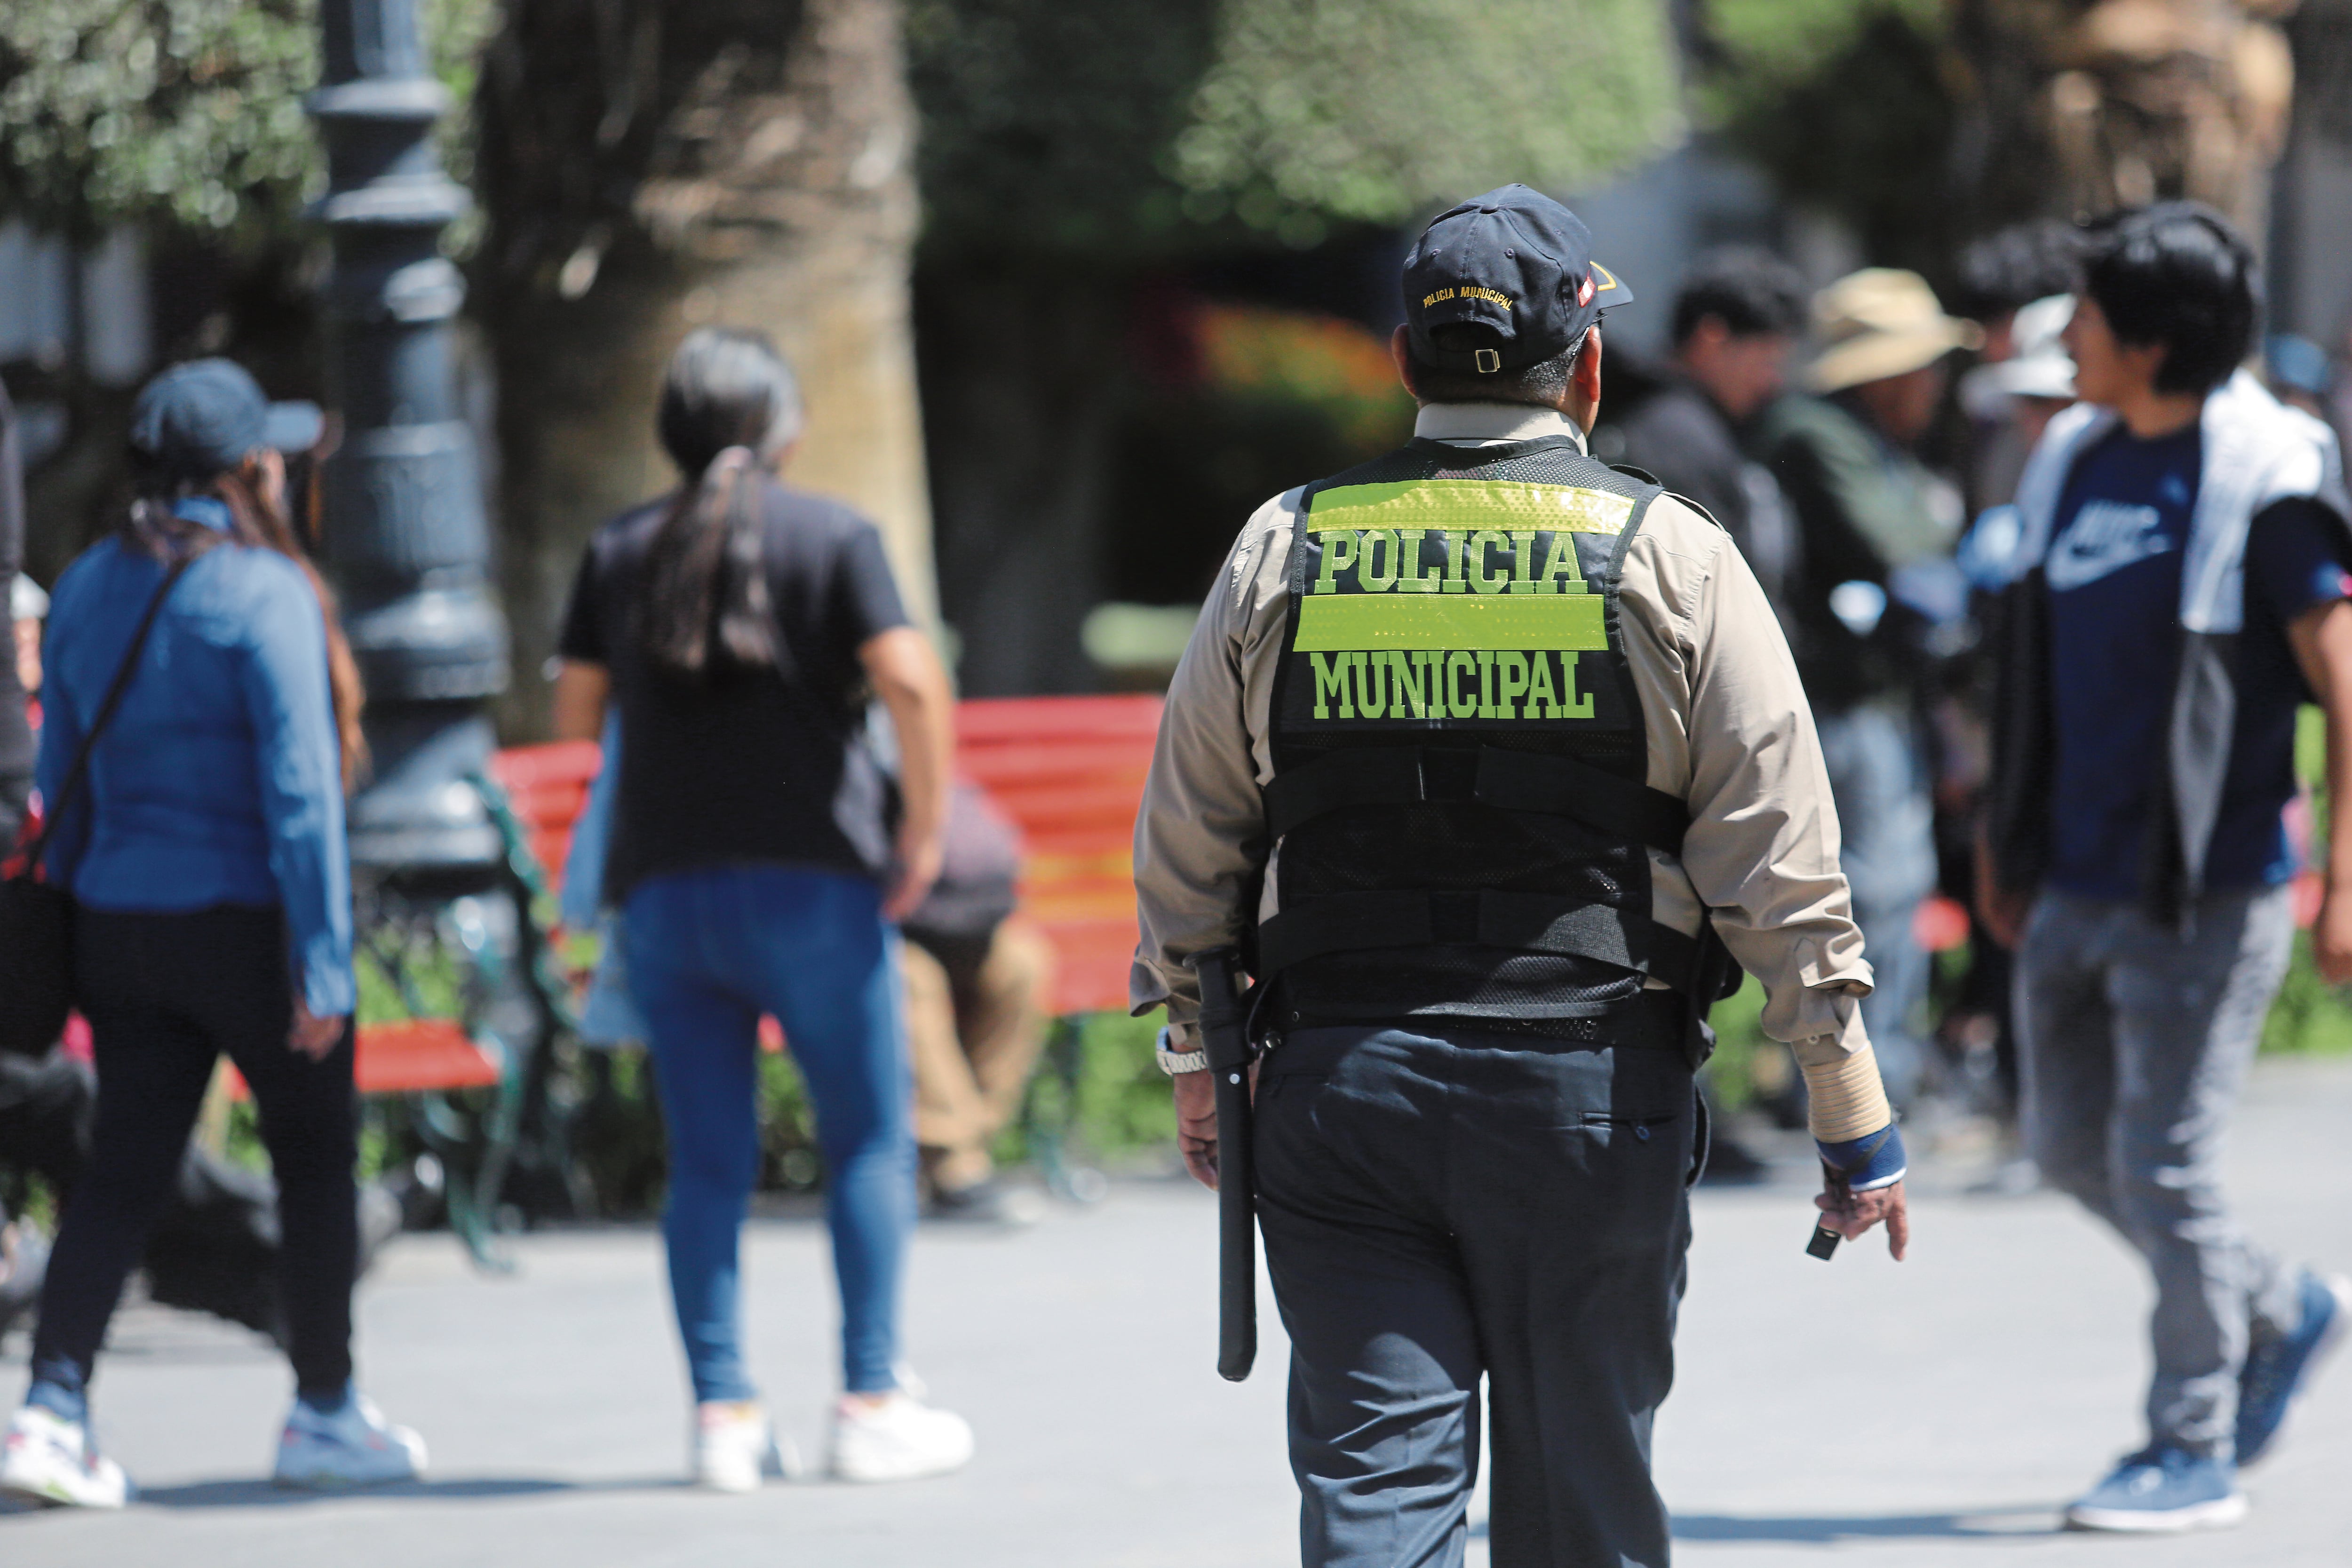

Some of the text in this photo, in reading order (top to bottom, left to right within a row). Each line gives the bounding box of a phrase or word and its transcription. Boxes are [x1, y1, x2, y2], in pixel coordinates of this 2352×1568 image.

[1423, 286, 1513, 311] POLICIA MUNICIPAL
[1314, 529, 1588, 594] POLICIA
[1310, 651, 1595, 719] MUNICIPAL
